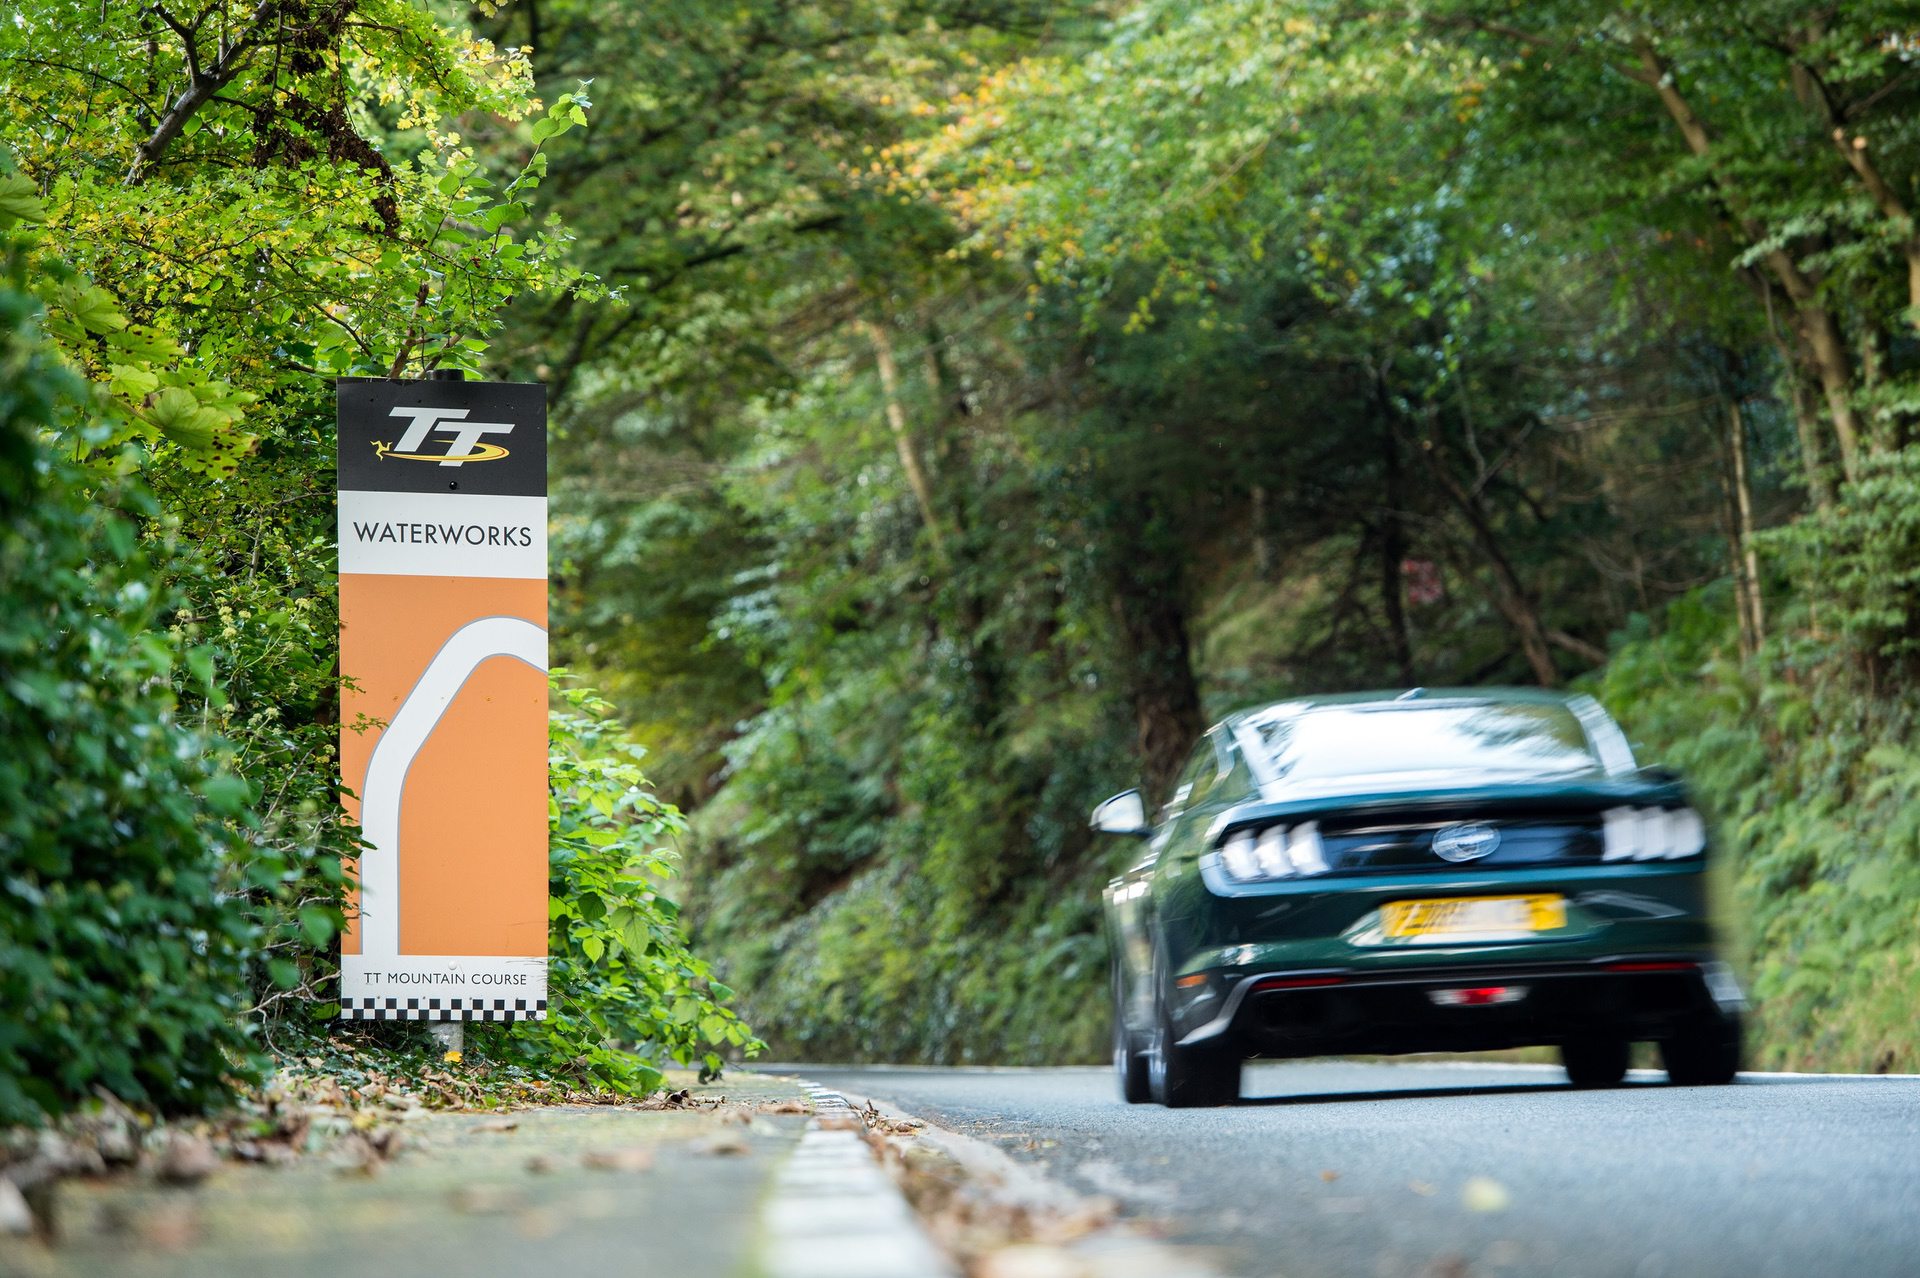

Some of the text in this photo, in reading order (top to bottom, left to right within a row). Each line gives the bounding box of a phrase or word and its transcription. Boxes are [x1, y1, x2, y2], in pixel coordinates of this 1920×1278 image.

[388, 406, 516, 467] TT
[353, 521, 532, 547] WATERWORKS
[363, 972, 527, 985] TT MOUNTAIN COURSE
